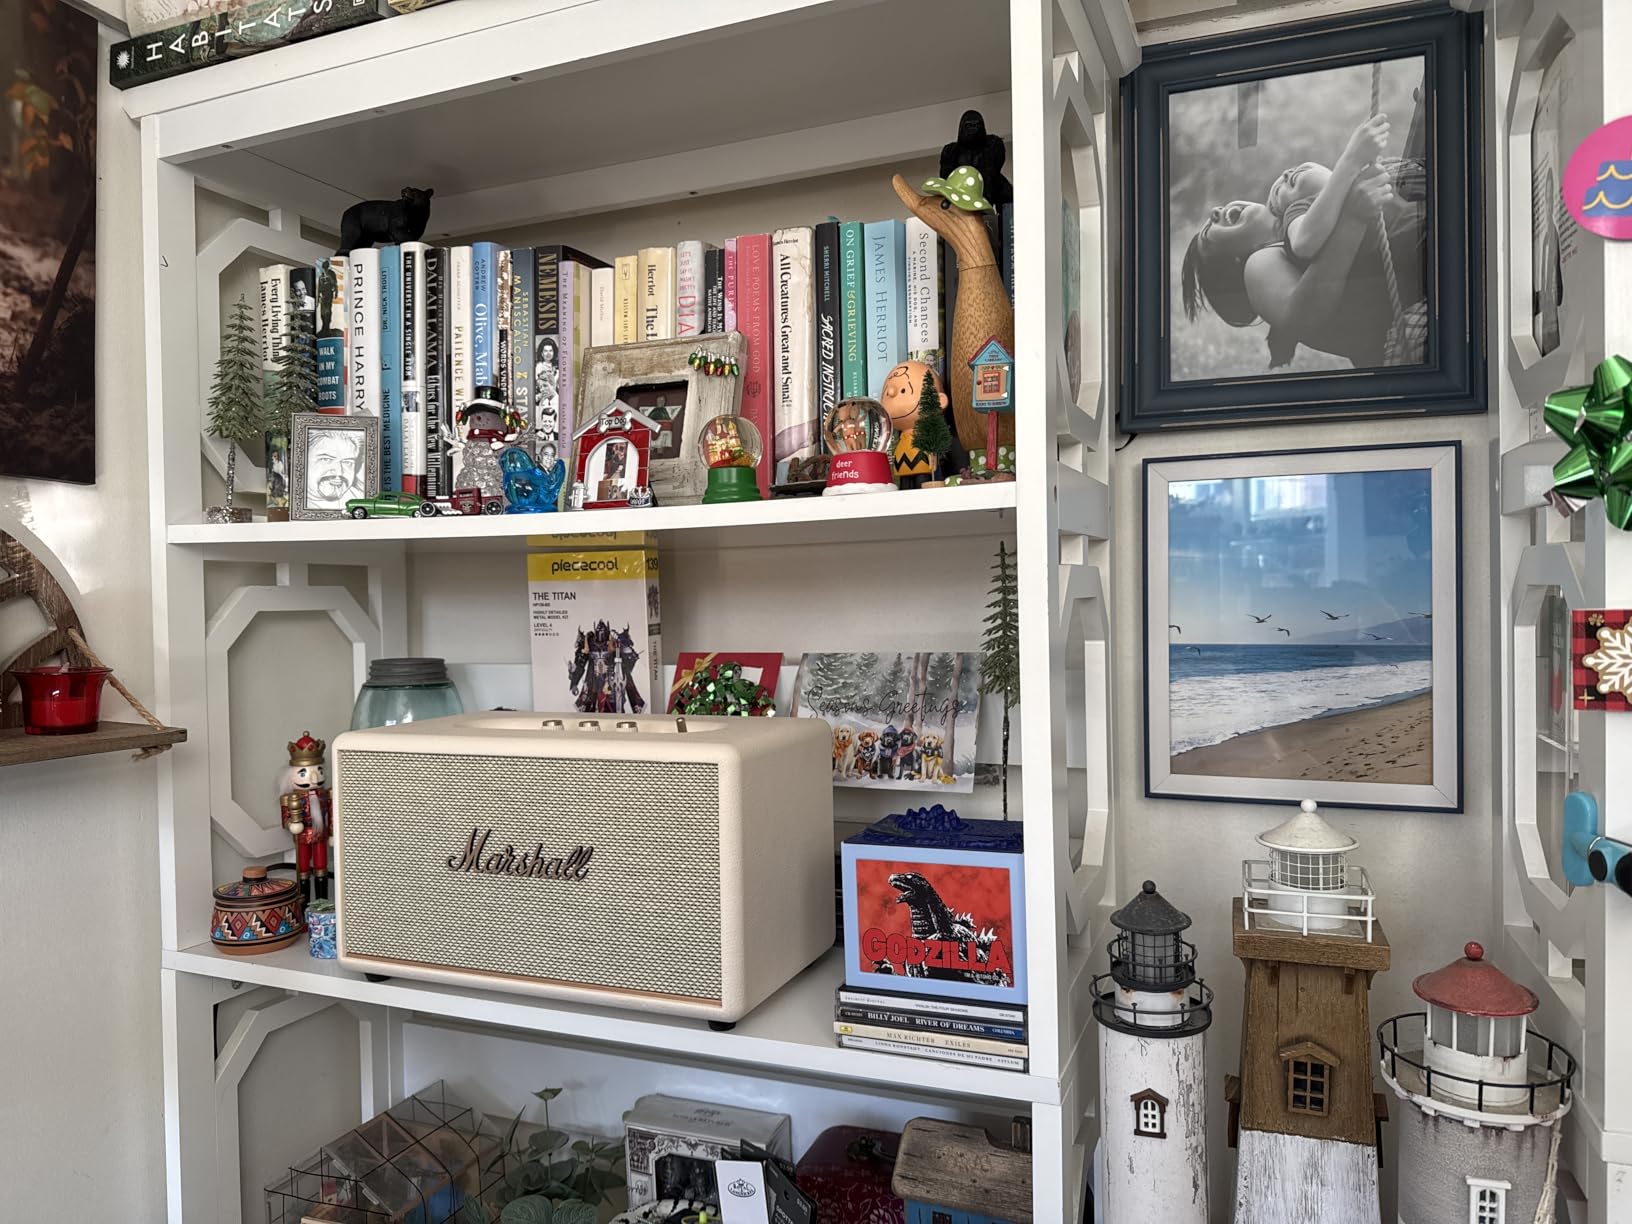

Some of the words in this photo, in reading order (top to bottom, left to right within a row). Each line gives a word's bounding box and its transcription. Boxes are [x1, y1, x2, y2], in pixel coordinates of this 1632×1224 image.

[147, 0, 332, 62] HABITATS
[845, 229, 855, 246] ON
[405, 256, 413, 268] THE
[752, 244, 760, 273] LOVE
[780, 254, 791, 270] All
[845, 250, 856, 288] GRIEF
[872, 235, 887, 283] JAMES
[918, 232, 931, 281] Second
[271, 278, 282, 303] Every
[405, 271, 413, 307] UNIVERSE
[426, 258, 438, 311] DALAI
[538, 253, 558, 330] NEMESIS
[648, 264, 656, 296] Herriot
[752, 276, 760, 312] POEMS
[260, 281, 269, 316] James
[353, 263, 365, 337] PRINCE
[381, 297, 389, 315] NICK
[780, 270, 792, 323] Creatures
[271, 305, 282, 333] Living
[405, 310, 413, 318] IN
[474, 303, 488, 348] Olive,
[513, 275, 521, 365] MANISCALCO
[645, 305, 658, 331] The
[678, 295, 697, 336] DIA
[876, 291, 888, 362] HERRIOT
[919, 286, 931, 344] Chances
[261, 320, 270, 362] Herriot
[405, 329, 413, 354] SINGLE
[426, 320, 438, 369] LAMA
[562, 336, 568, 346] OF
[752, 315, 760, 346] FROM
[780, 324, 793, 354] Great
[820, 313, 834, 360] SACRED
[847, 300, 857, 361] GRIEVING
[319, 346, 335, 356] WALK
[326, 361, 336, 370] MY
[454, 326, 464, 382] PATIENCE
[752, 350, 760, 373] GOD
[781, 355, 793, 375] and
[317, 376, 340, 386] COMBAT
[354, 345, 366, 412] HARRY
[405, 357, 413, 377] ATOM
[474, 352, 488, 386] Mab
[319, 391, 337, 401] BOOTS
[426, 374, 440, 401] Ethics
[821, 361, 835, 419] INSTRUC
[381, 387, 391, 432] MEDICINE
[427, 402, 440, 414] for
[427, 416, 440, 429] the
[601, 418, 613, 429] Top
[614, 417, 627, 426] Dog
[382, 434, 392, 456] BEST
[383, 458, 392, 474] THE
[427, 452, 441, 497] Millennium
[832, 470, 860, 481] friends
[836, 460, 853, 469] deer
[383, 476, 392, 485] IS
[551, 556, 620, 575] piececool
[646, 557, 659, 571] 139
[532, 592, 550, 601] THE
[552, 591, 577, 601] TITAN
[807, 685, 873, 720] Seasons
[878, 686, 961, 726] Greetings
[448, 828, 595, 882] Marshall
[861, 928, 1013, 976] GODZILLA
[867, 1012, 890, 1021] BILLY
[891, 1015, 910, 1024] JOEL
[915, 1018, 939, 1027] RIVER
[939, 1021, 949, 1029] OF
[952, 1023, 985, 1033] DREAMS
[886, 1032, 902, 1040] MAX
[904, 1034, 935, 1044] RICHTER
[945, 1039, 971, 1048] EXILES
